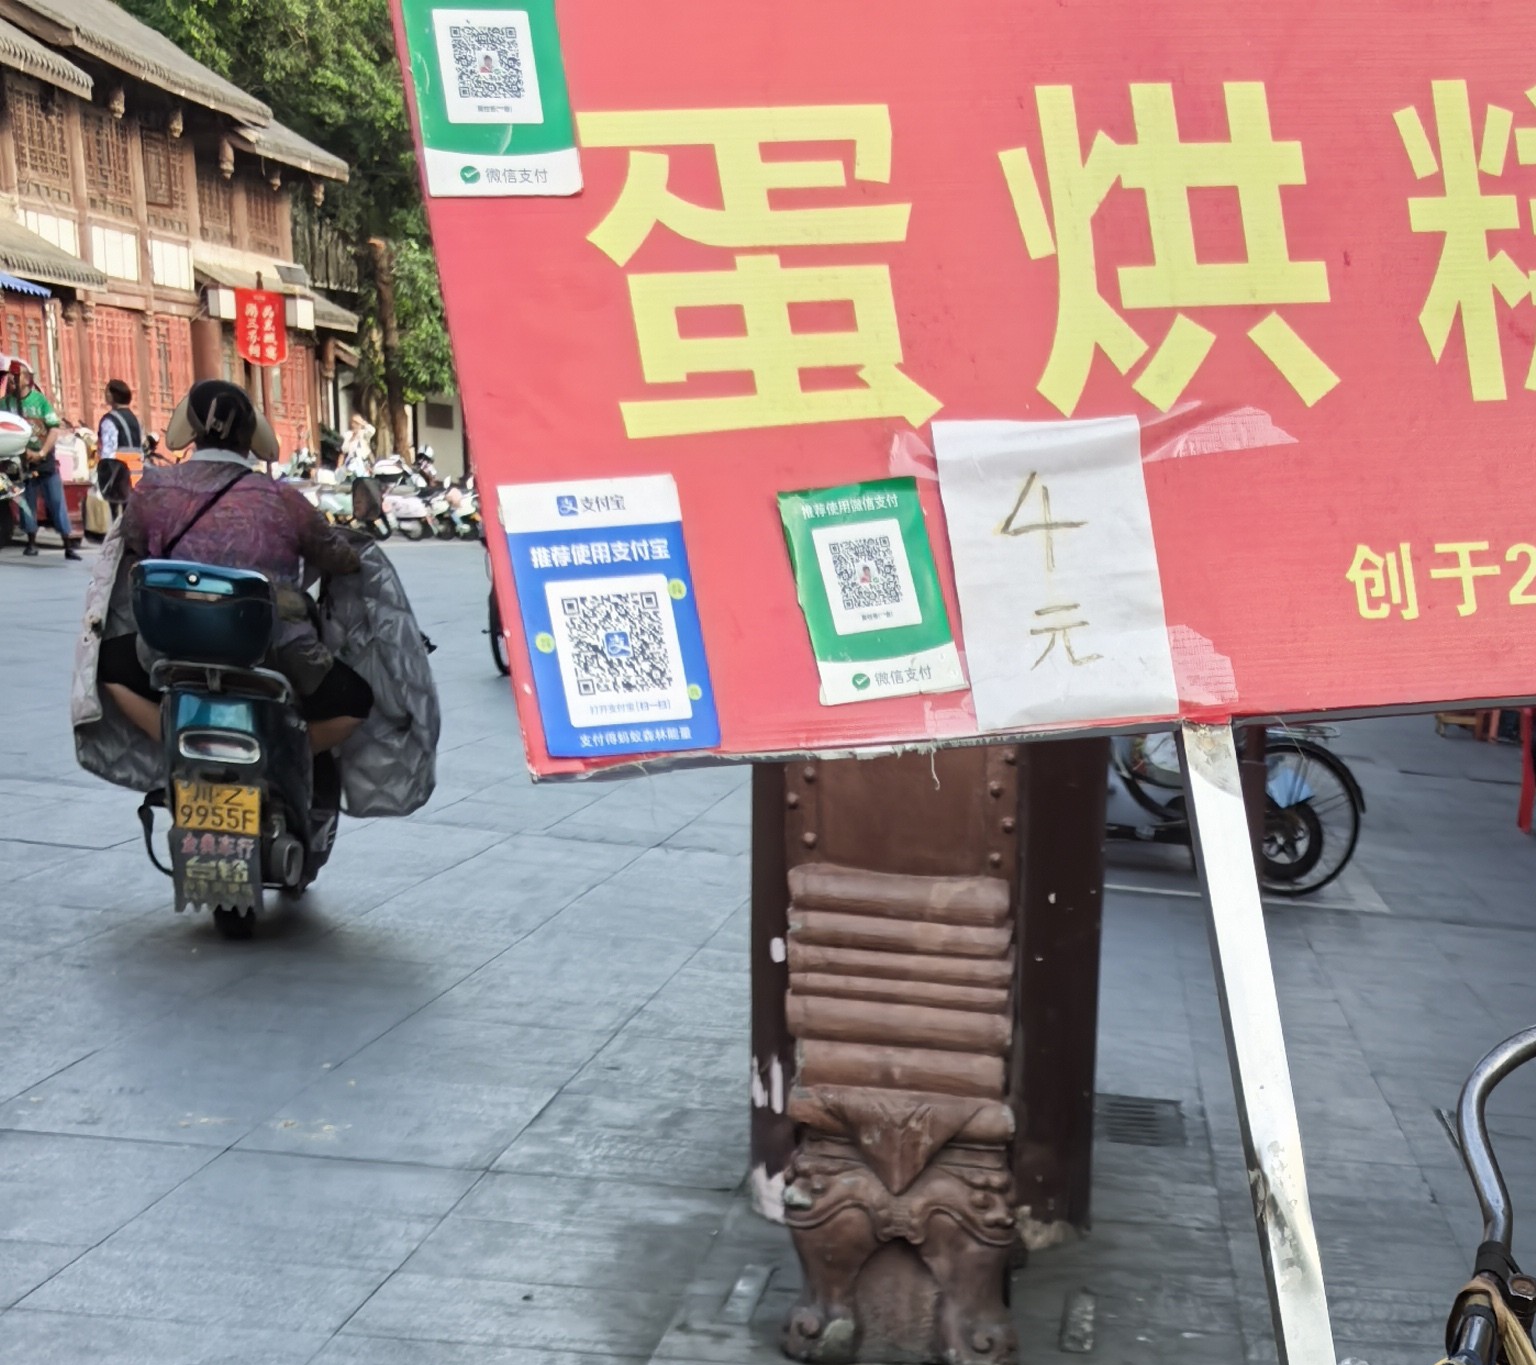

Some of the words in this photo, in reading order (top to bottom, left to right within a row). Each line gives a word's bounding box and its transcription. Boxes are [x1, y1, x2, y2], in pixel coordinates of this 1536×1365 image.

[485, 167, 548, 184] 微信支付
[580, 494, 626, 512] 支付宝
[801, 494, 899, 520] 推荐使用微信支付
[529, 537, 671, 569] 推荐使用支付宝
[874, 665, 931, 686] 微信支付
[181, 804, 256, 830] 9955F
